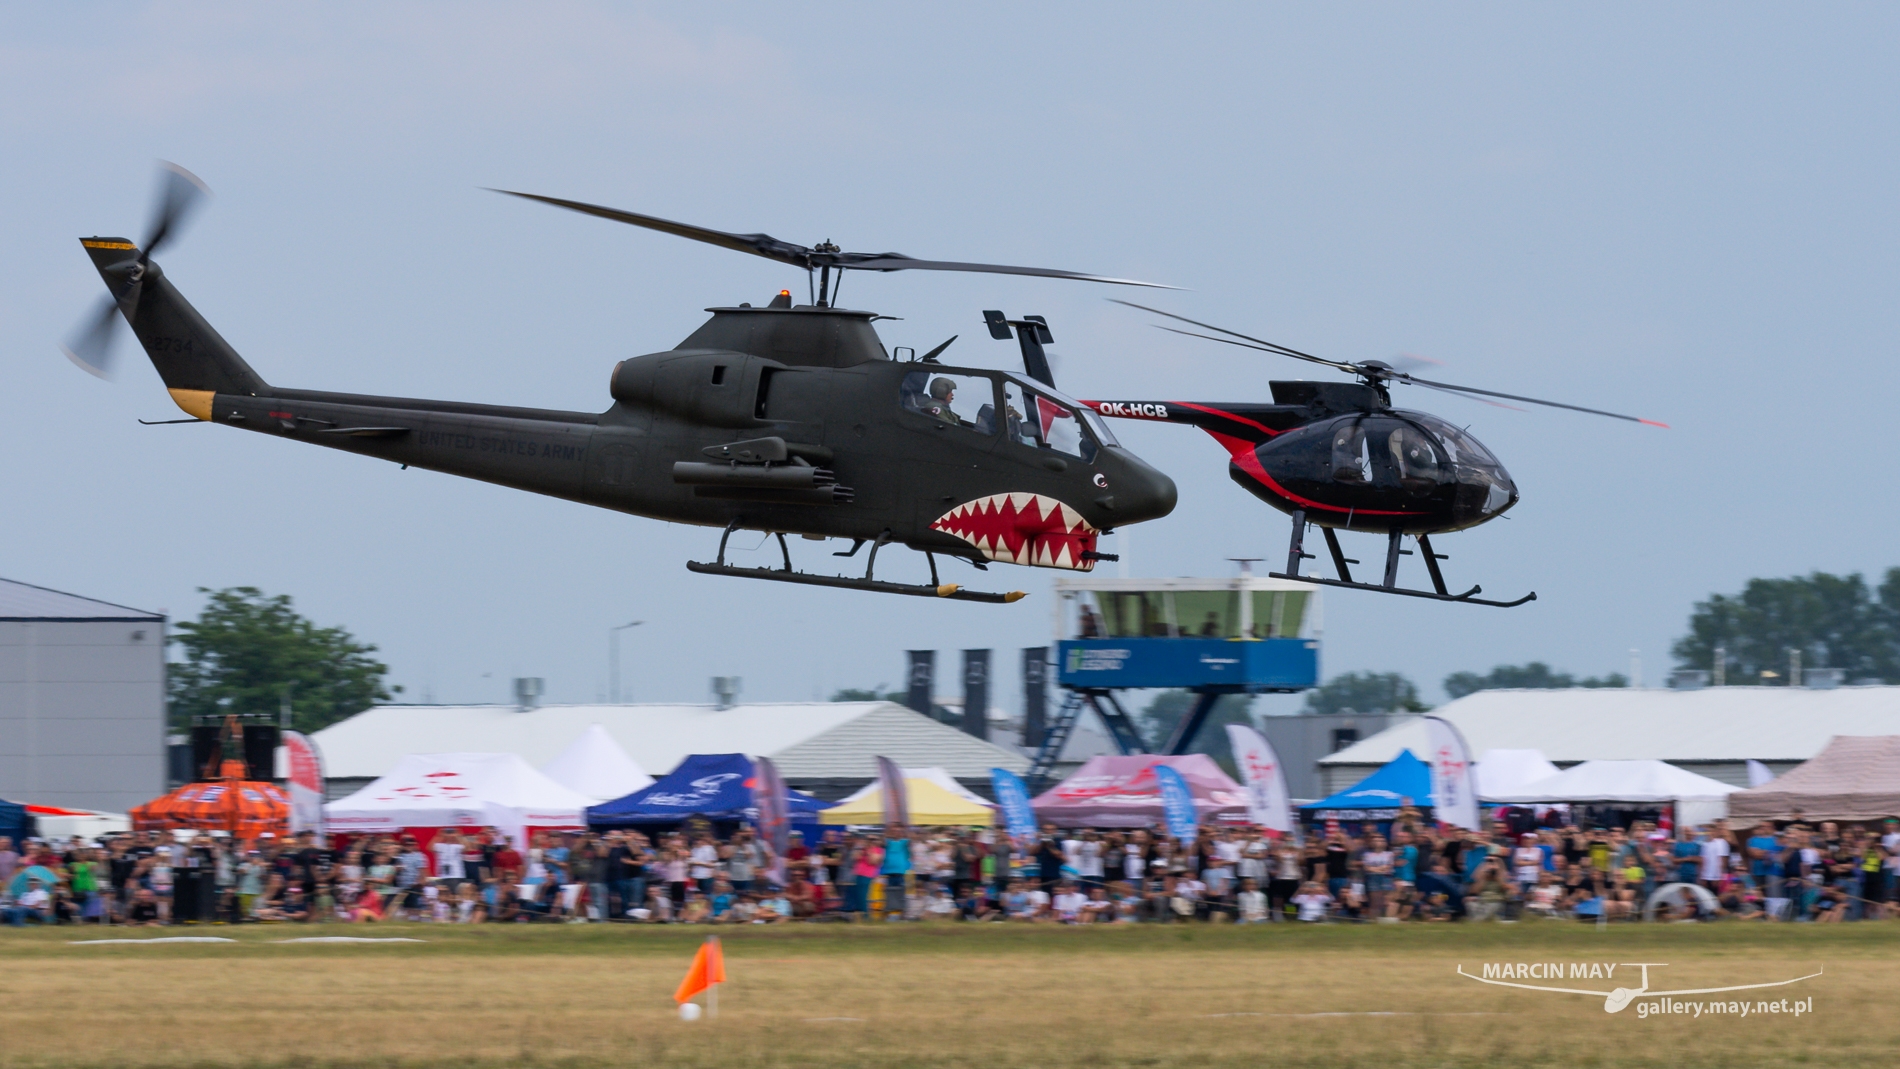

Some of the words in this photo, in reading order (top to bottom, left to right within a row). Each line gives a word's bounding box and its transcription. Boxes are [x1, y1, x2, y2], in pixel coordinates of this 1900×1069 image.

[1099, 402, 1168, 418] OK-HCB
[418, 430, 476, 450] UNITED
[479, 436, 538, 457] STATES
[541, 442, 587, 462] ARMY
